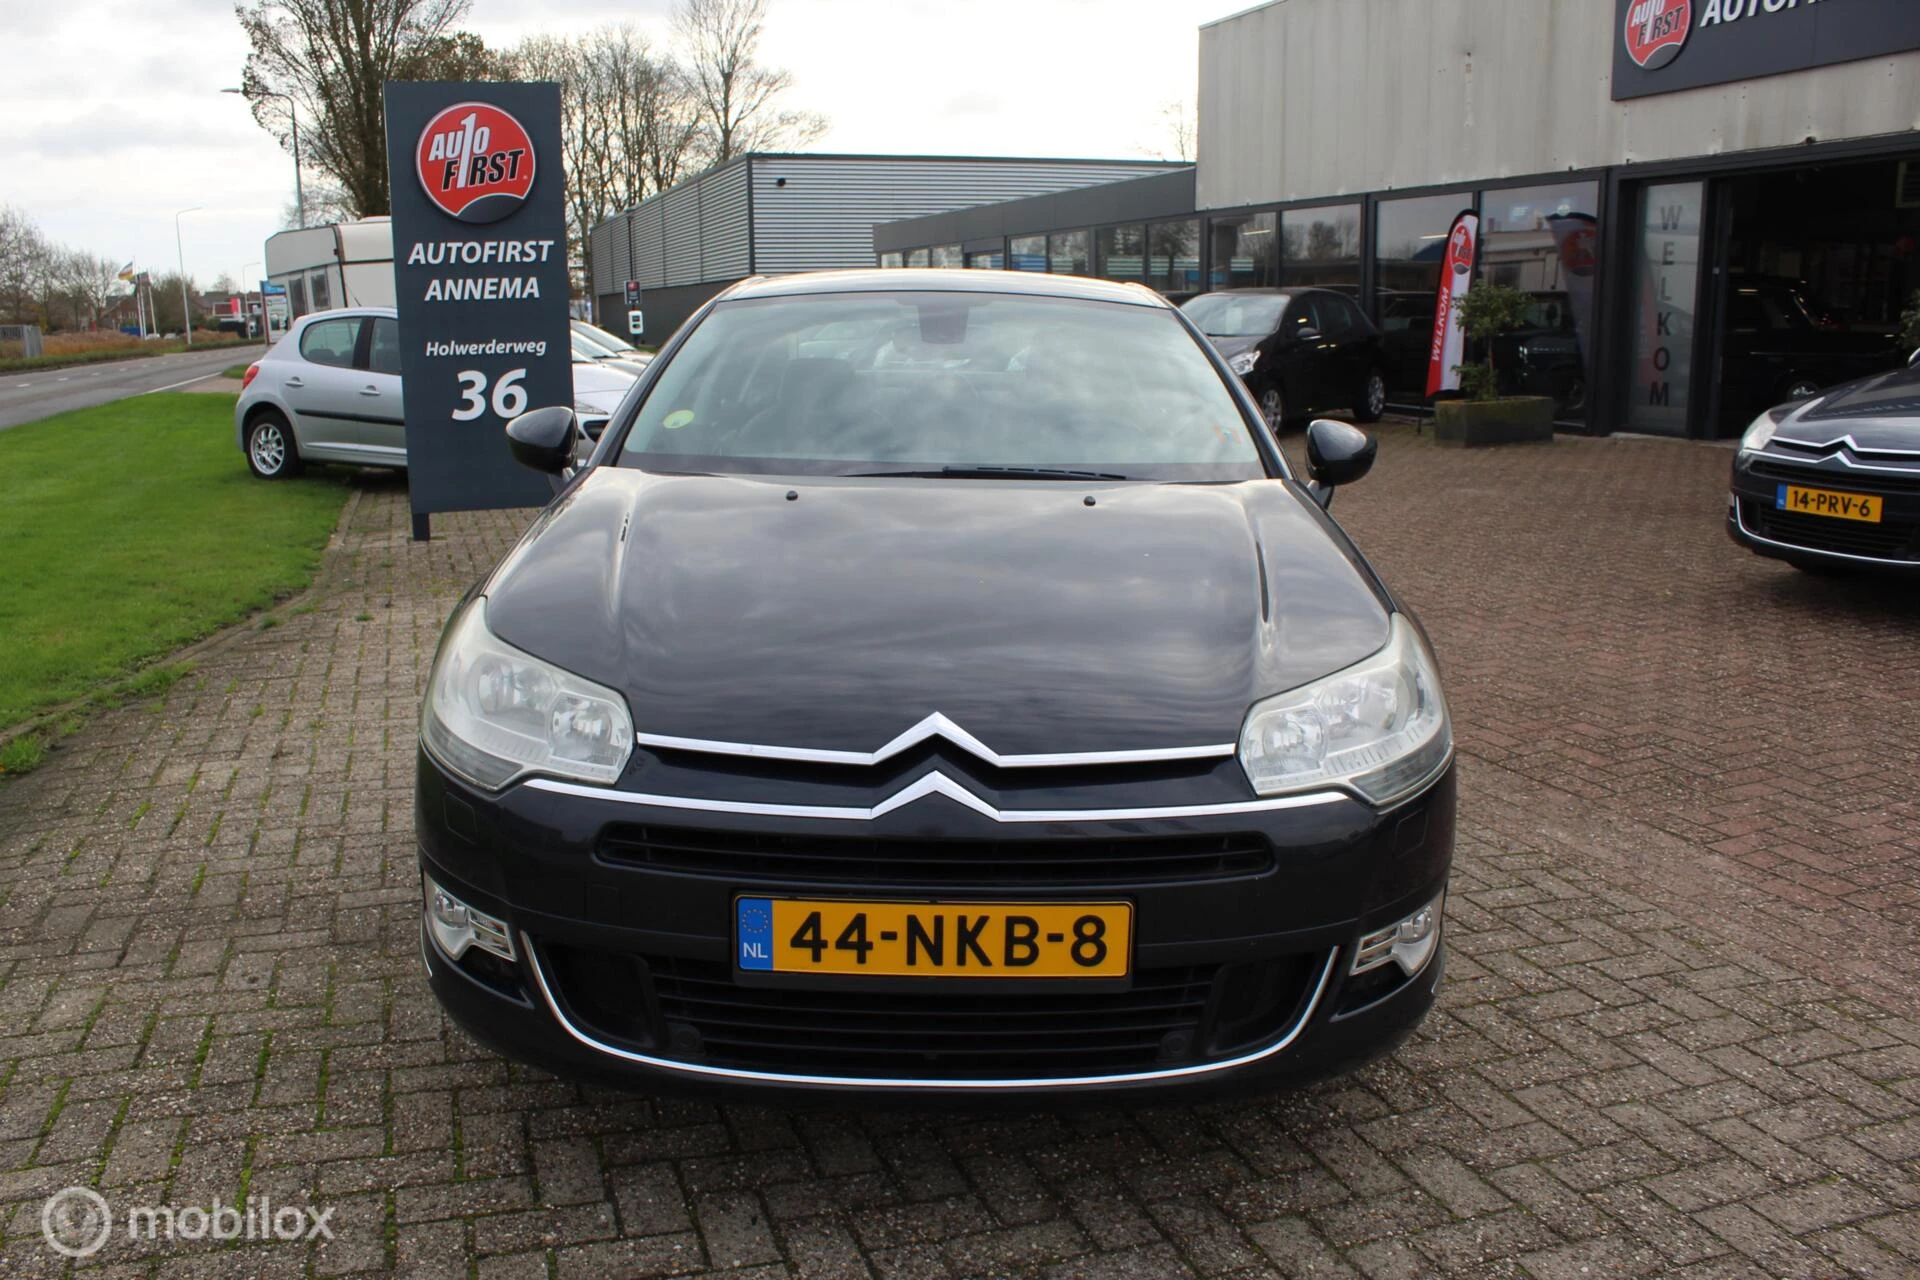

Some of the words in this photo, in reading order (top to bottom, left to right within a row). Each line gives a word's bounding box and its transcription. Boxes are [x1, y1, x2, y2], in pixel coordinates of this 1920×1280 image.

[408, 240, 554, 265] AUTOFIRST
[424, 277, 540, 301] ANNEMA
[1432, 287, 1449, 361] WELKOM
[426, 339, 547, 357] Holwerderweg
[452, 368, 528, 422] 36
[1793, 490, 1871, 517] 14-PRV-6
[743, 942, 769, 959] NL
[790, 911, 1108, 968] 44-NKB-8
